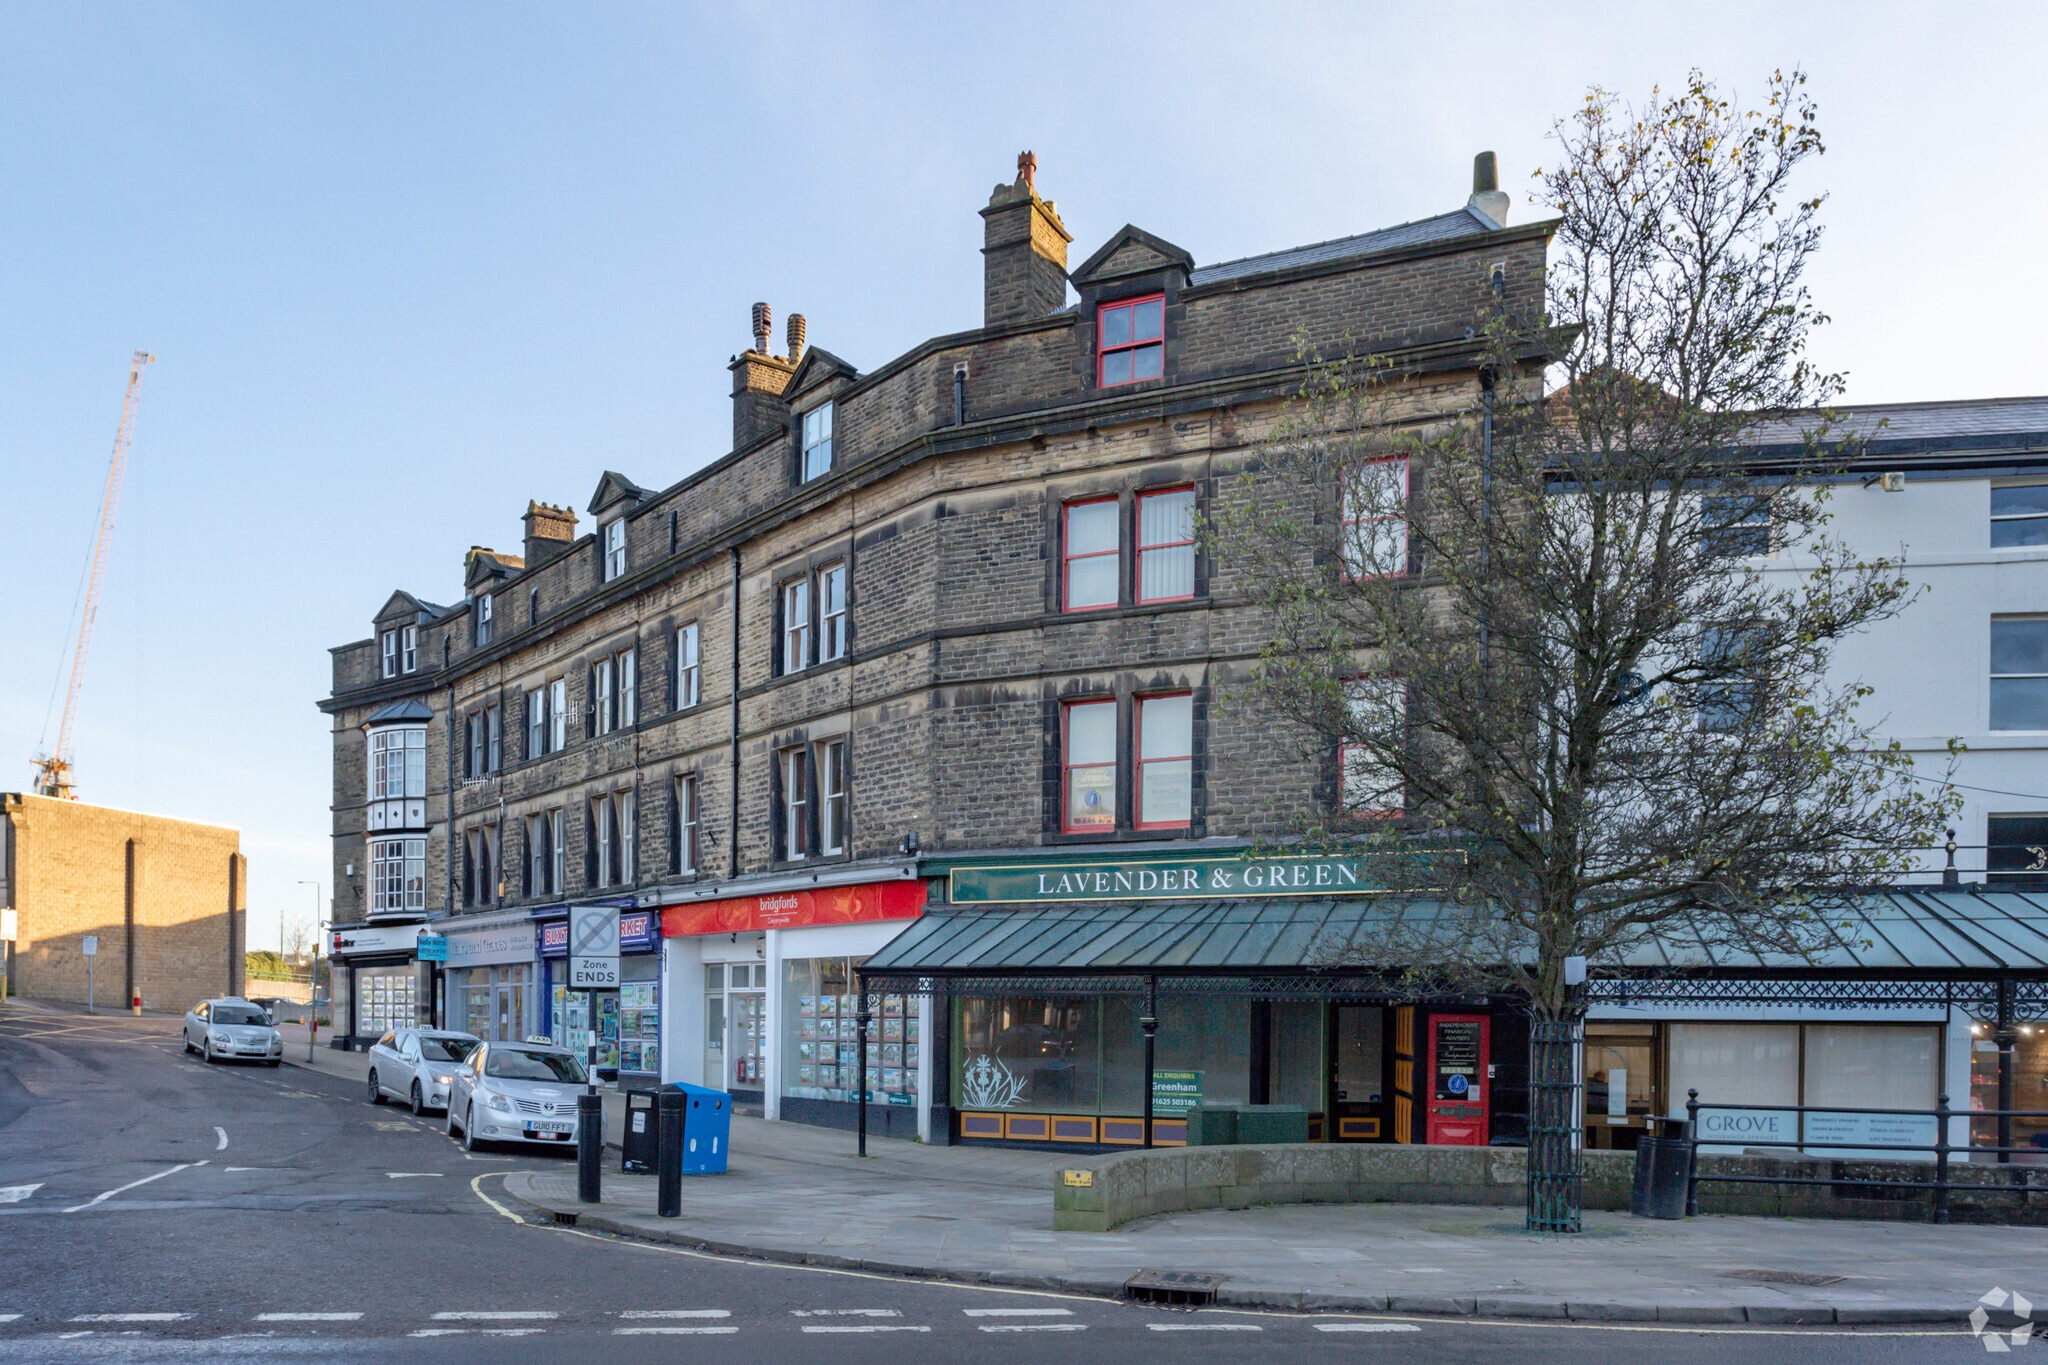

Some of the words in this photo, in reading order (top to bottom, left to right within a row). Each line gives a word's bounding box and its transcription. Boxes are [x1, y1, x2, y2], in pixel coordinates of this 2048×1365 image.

[1038, 868, 1200, 894] LAVENDER
[1211, 867, 1233, 889] &
[1243, 863, 1357, 888] GREEN
[760, 894, 798, 913] bridgfords
[545, 927, 568, 946] BUXT
[621, 917, 648, 937] RKET
[583, 960, 608, 969] Zone
[576, 972, 615, 982] ENDS
[1152, 1081, 1197, 1092] Greenham
[1171, 1098, 1197, 1106] 503186
[551, 1123, 566, 1131] FFT
[1706, 1115, 1779, 1132] GROVE
